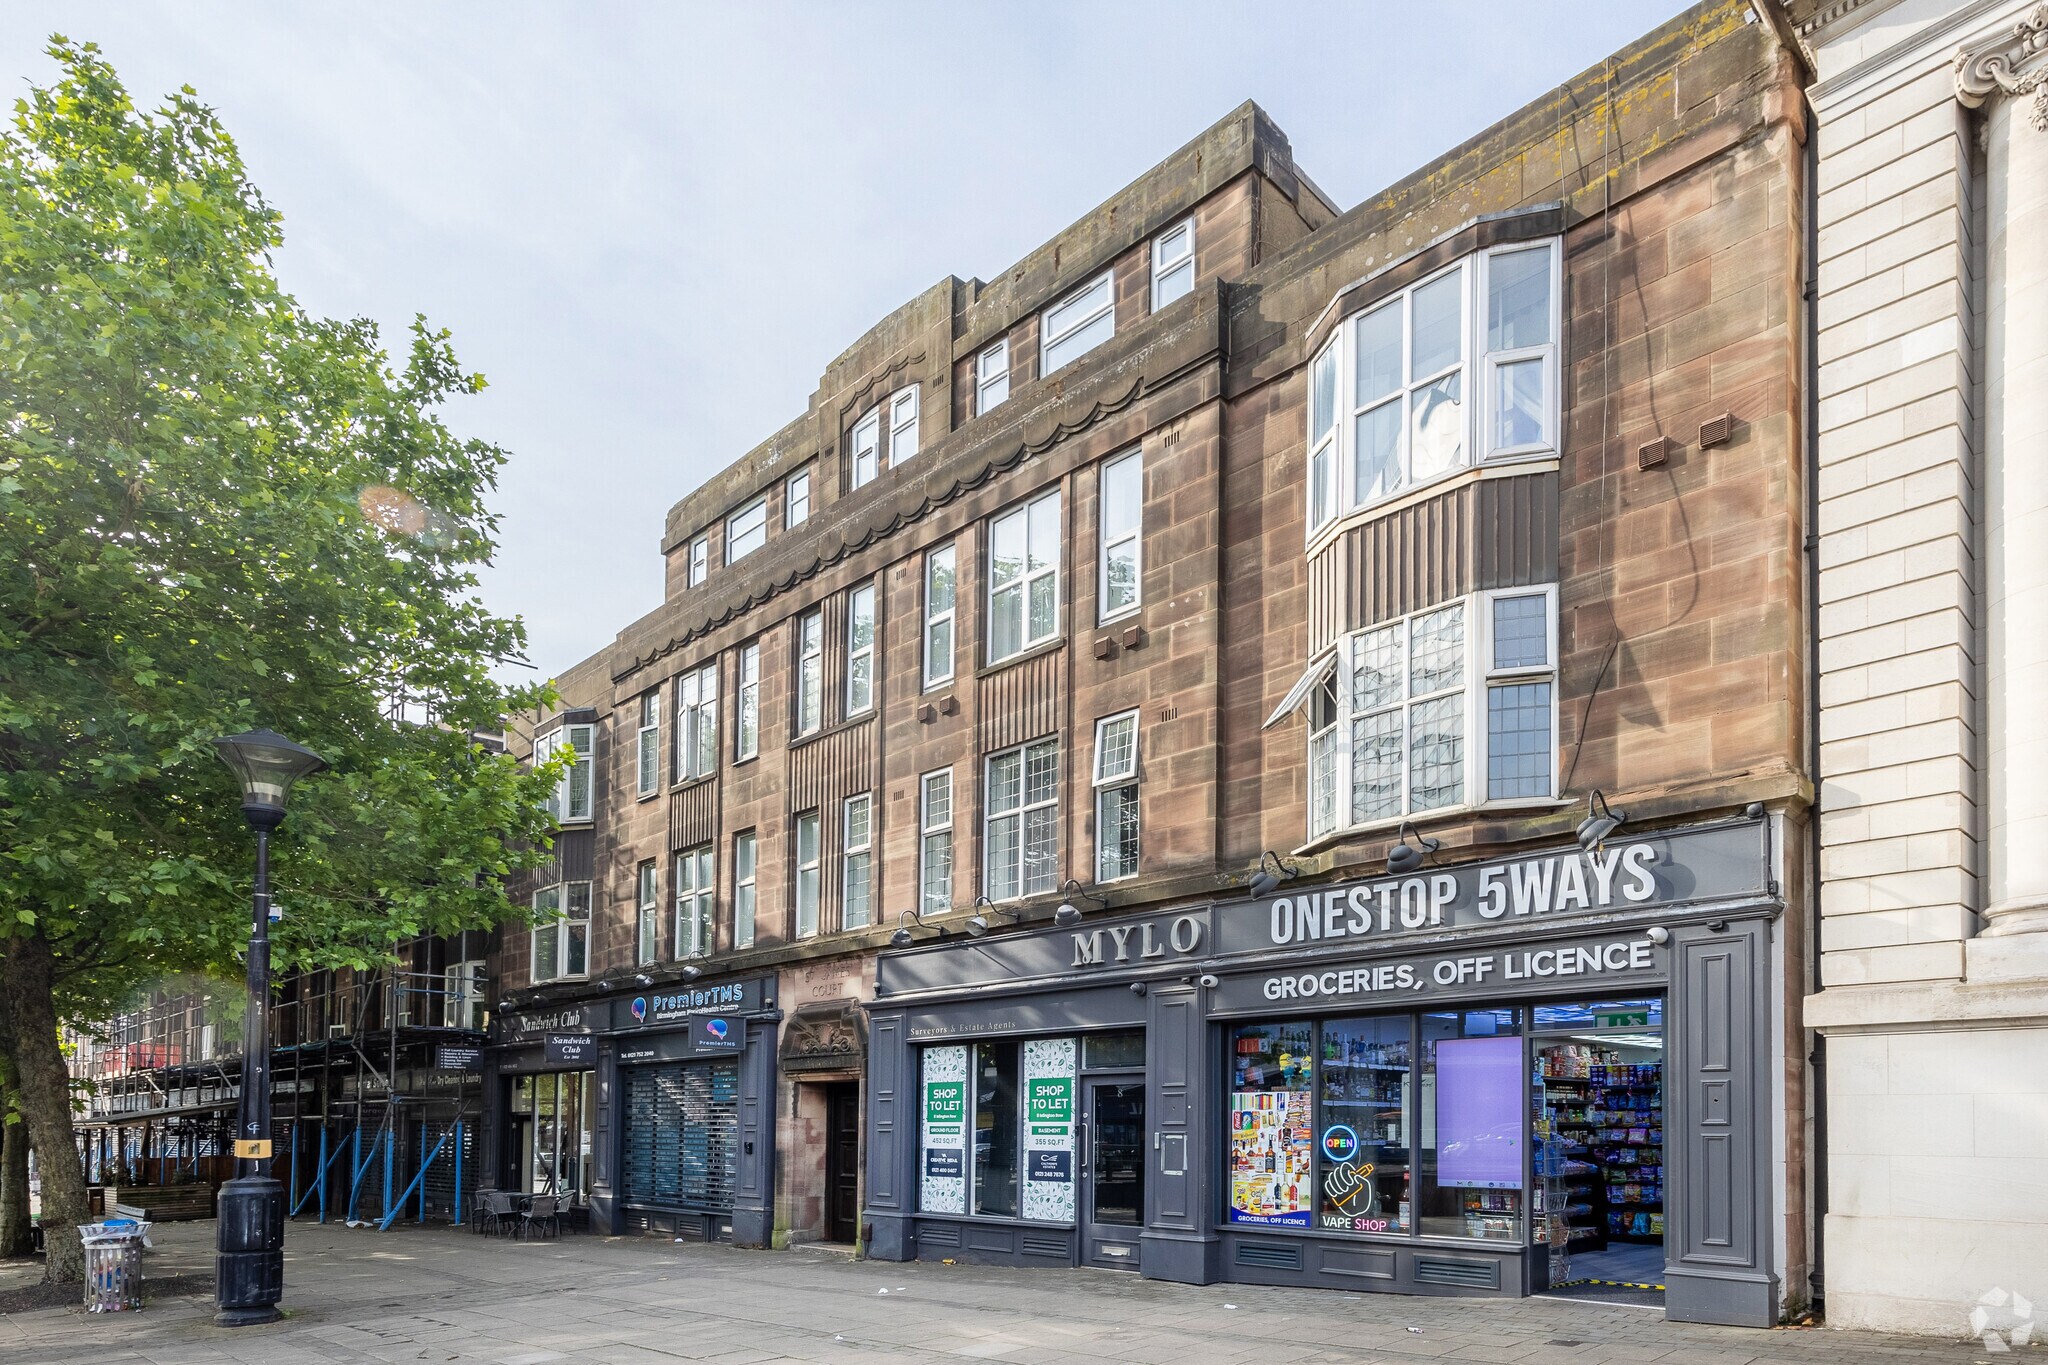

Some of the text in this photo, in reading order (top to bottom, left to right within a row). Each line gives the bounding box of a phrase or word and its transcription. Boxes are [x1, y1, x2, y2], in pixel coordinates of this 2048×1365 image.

[1270, 843, 1656, 945] ONESTOP 5WAYS
[1071, 916, 1202, 967] MYLO
[1264, 941, 1652, 1000] GROCERIES, OFF LICENCE
[812, 983, 843, 997] COURT
[653, 984, 743, 1011] PremierTMS
[656, 1010, 687, 1020] Birmingham
[521, 1010, 580, 1032] Sandwich Club
[910, 1026, 948, 1036] Surveyors
[960, 1023, 985, 1032] Estate
[987, 1021, 1016, 1031] Agents
[552, 1036, 591, 1045] Sandwich
[933, 1089, 957, 1099] SHOP
[1036, 1085, 1064, 1096] SHOP
[1117, 1088, 1123, 1098] 8
[930, 1101, 961, 1111] TO LET
[1031, 1098, 1068, 1109] TO LET
[1326, 1138, 1353, 1148] OPEN
[1238, 1215, 1269, 1223] GROCERIES,
[1282, 1218, 1306, 1226] LICENCE
[1322, 1216, 1387, 1231] VAPE SHOP
